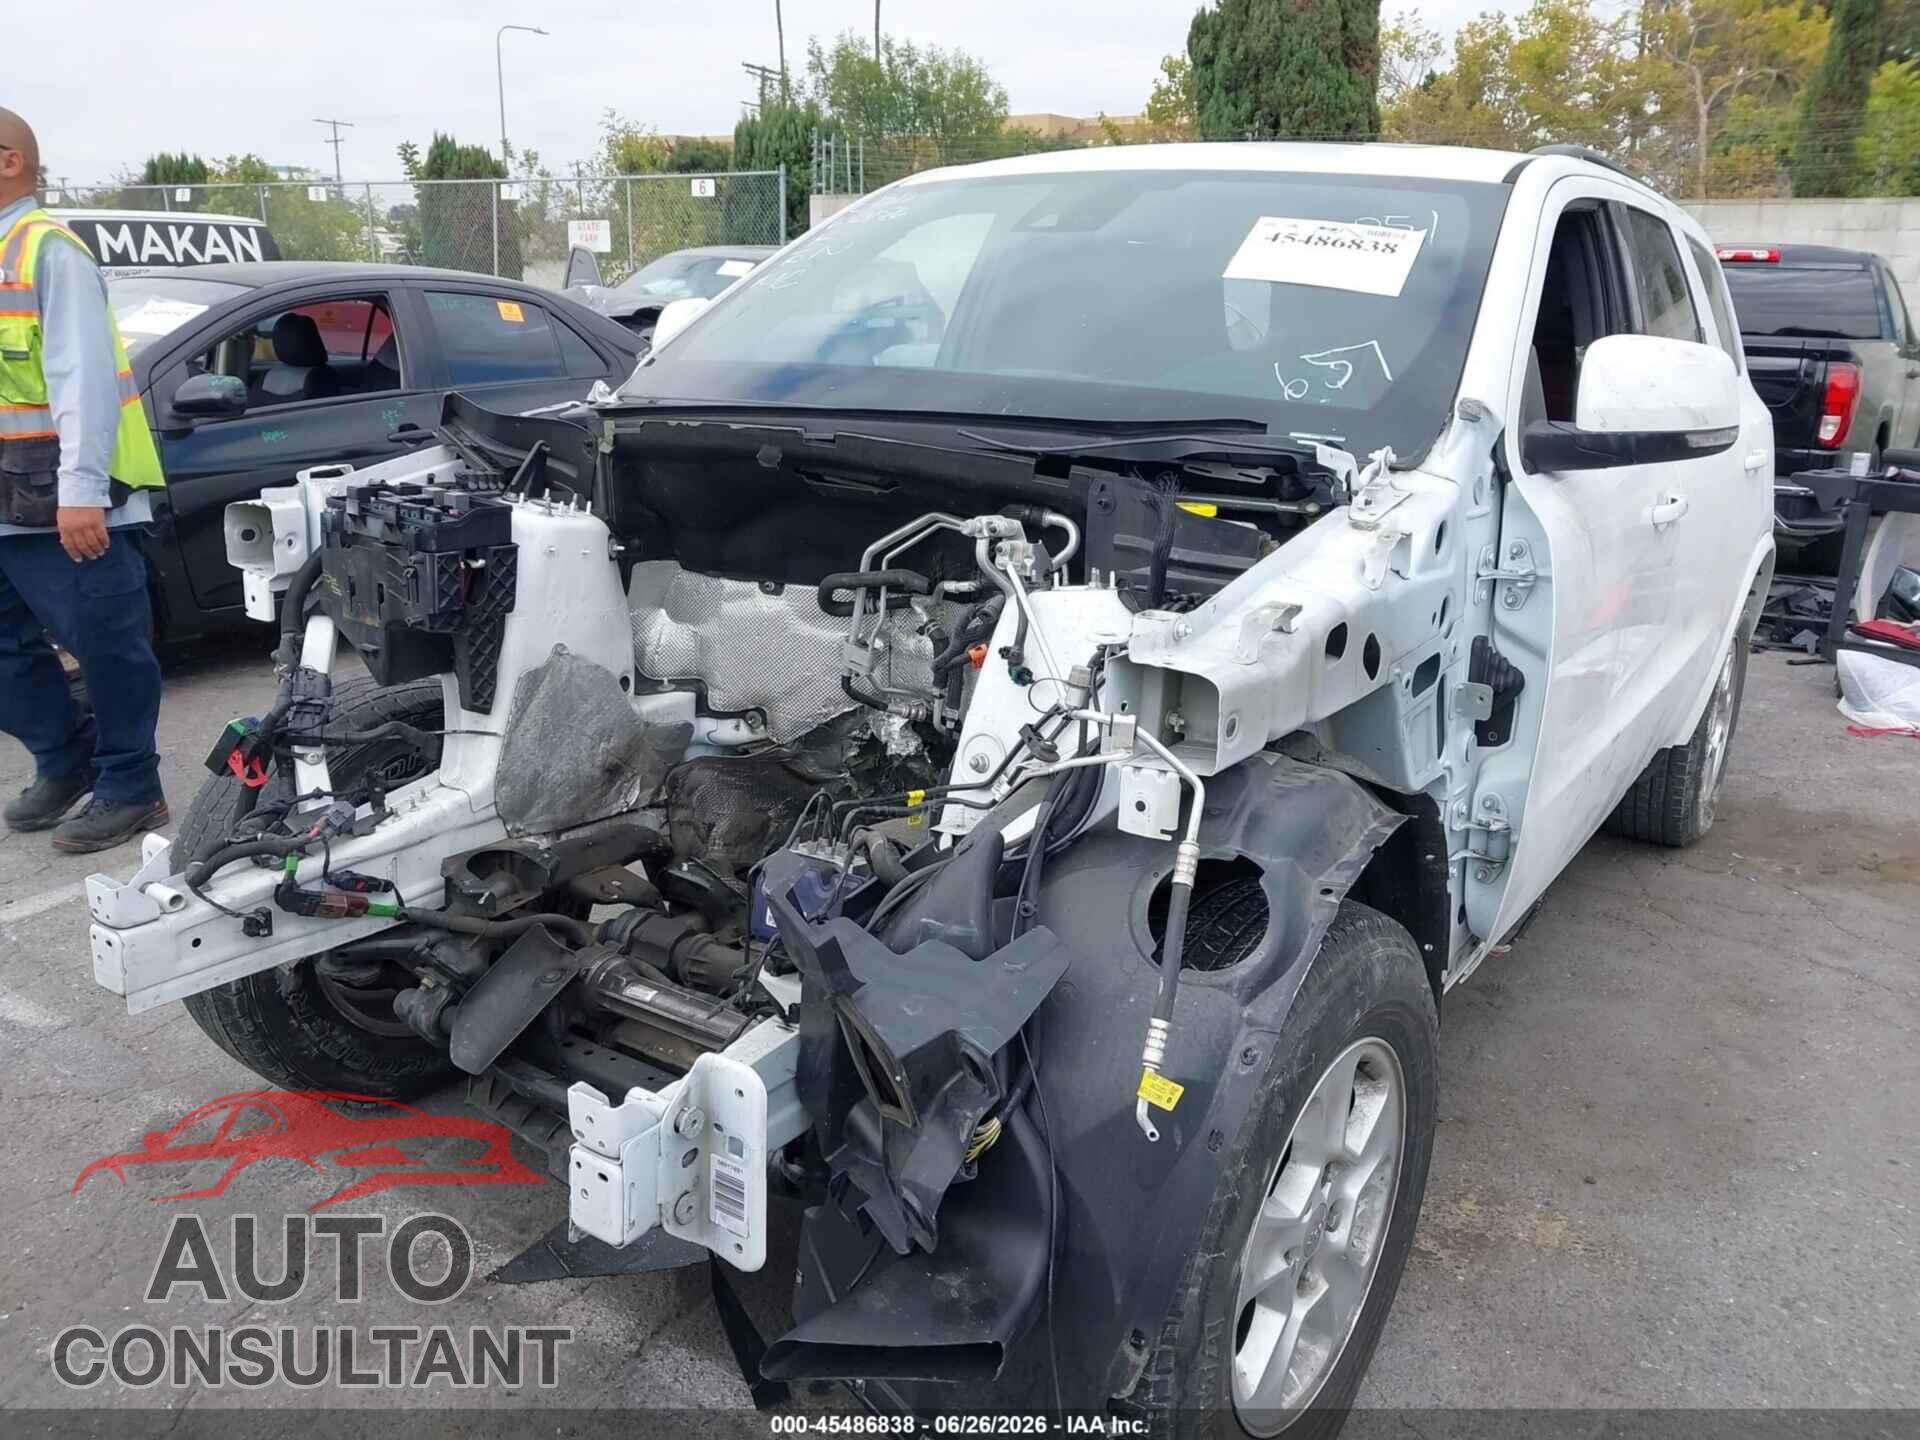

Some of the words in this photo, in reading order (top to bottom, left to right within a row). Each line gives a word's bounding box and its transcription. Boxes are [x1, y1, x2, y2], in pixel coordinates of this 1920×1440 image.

[698, 180, 706, 195] 6
[95, 223, 263, 263] MAKAN
[1264, 231, 1399, 254] 45486838
